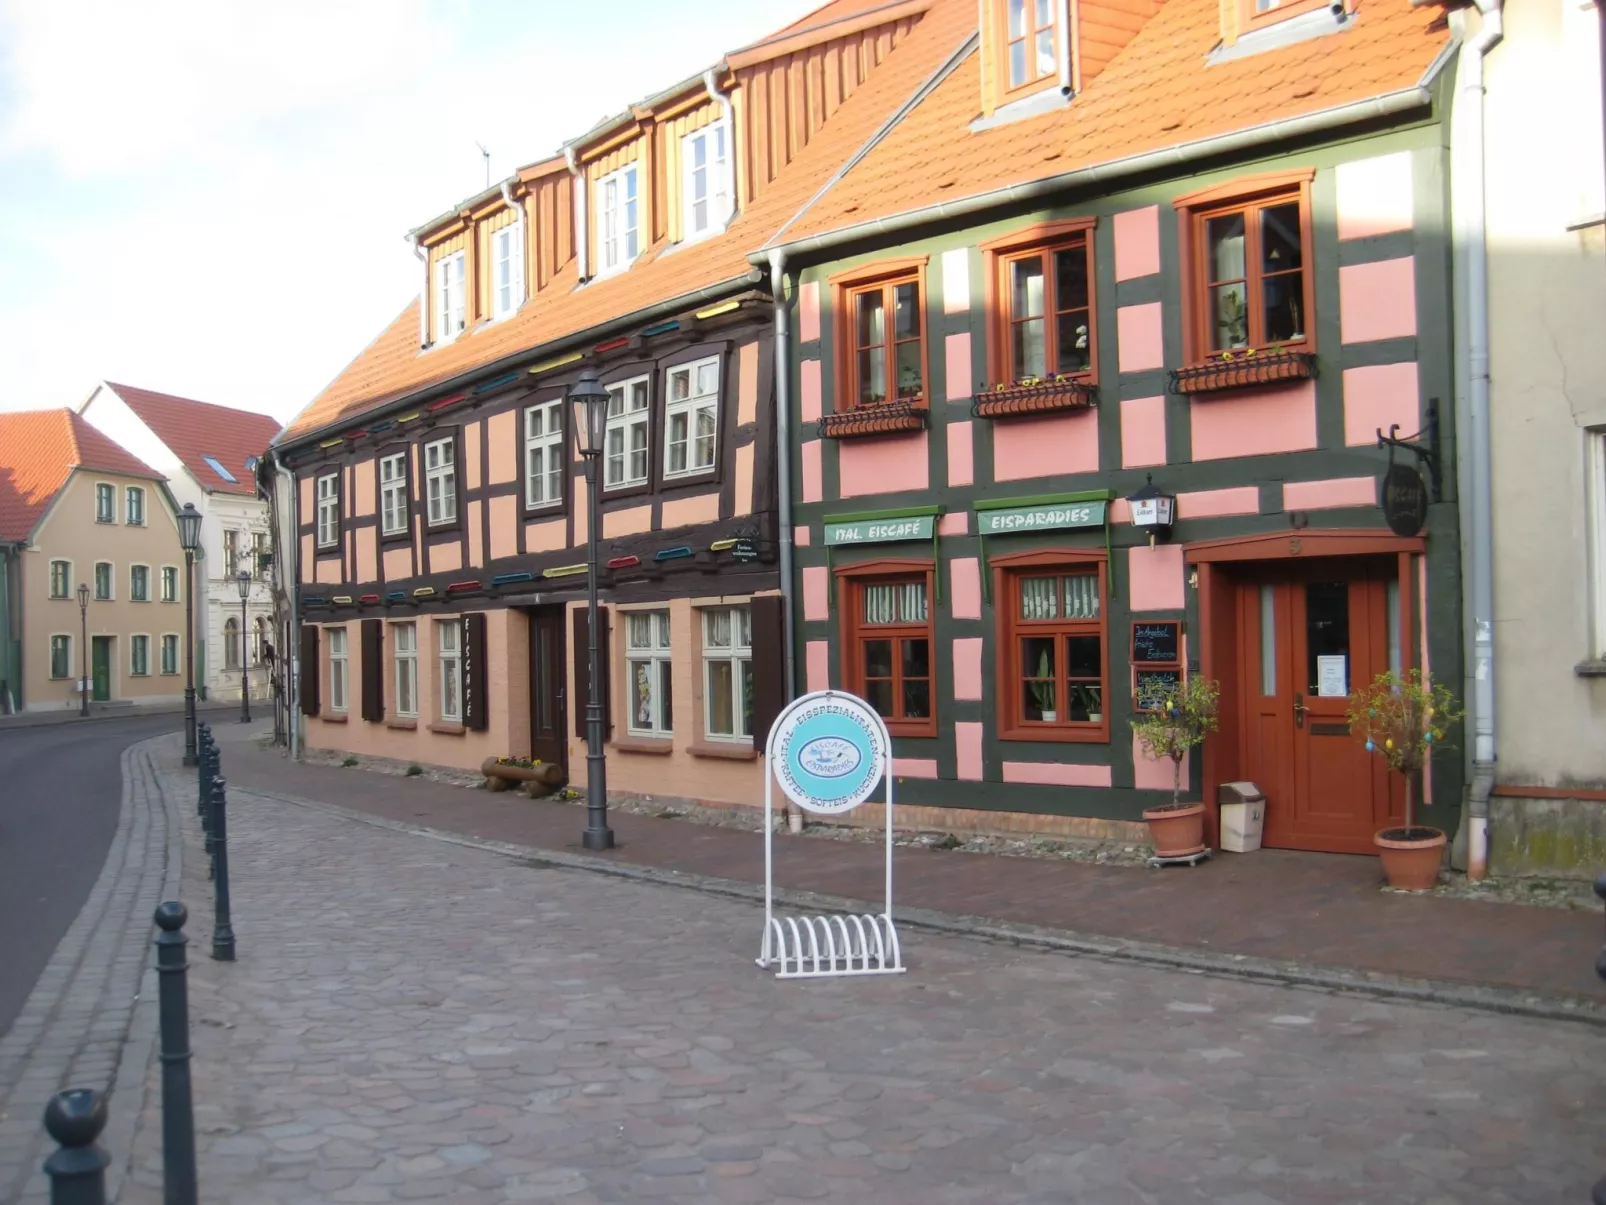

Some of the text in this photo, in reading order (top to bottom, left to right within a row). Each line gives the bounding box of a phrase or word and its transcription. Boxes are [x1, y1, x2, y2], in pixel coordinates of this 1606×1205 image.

[835, 519, 921, 541] ITAL. EISCAFÉ
[991, 508, 1090, 528] EISPARADIES
[464, 618, 472, 717] EISCAFÉ
[796, 705, 879, 756] EISSPEZIALITÄTEN
[780, 764, 878, 807] KAFFEE SOFTEIS KUCHEN
